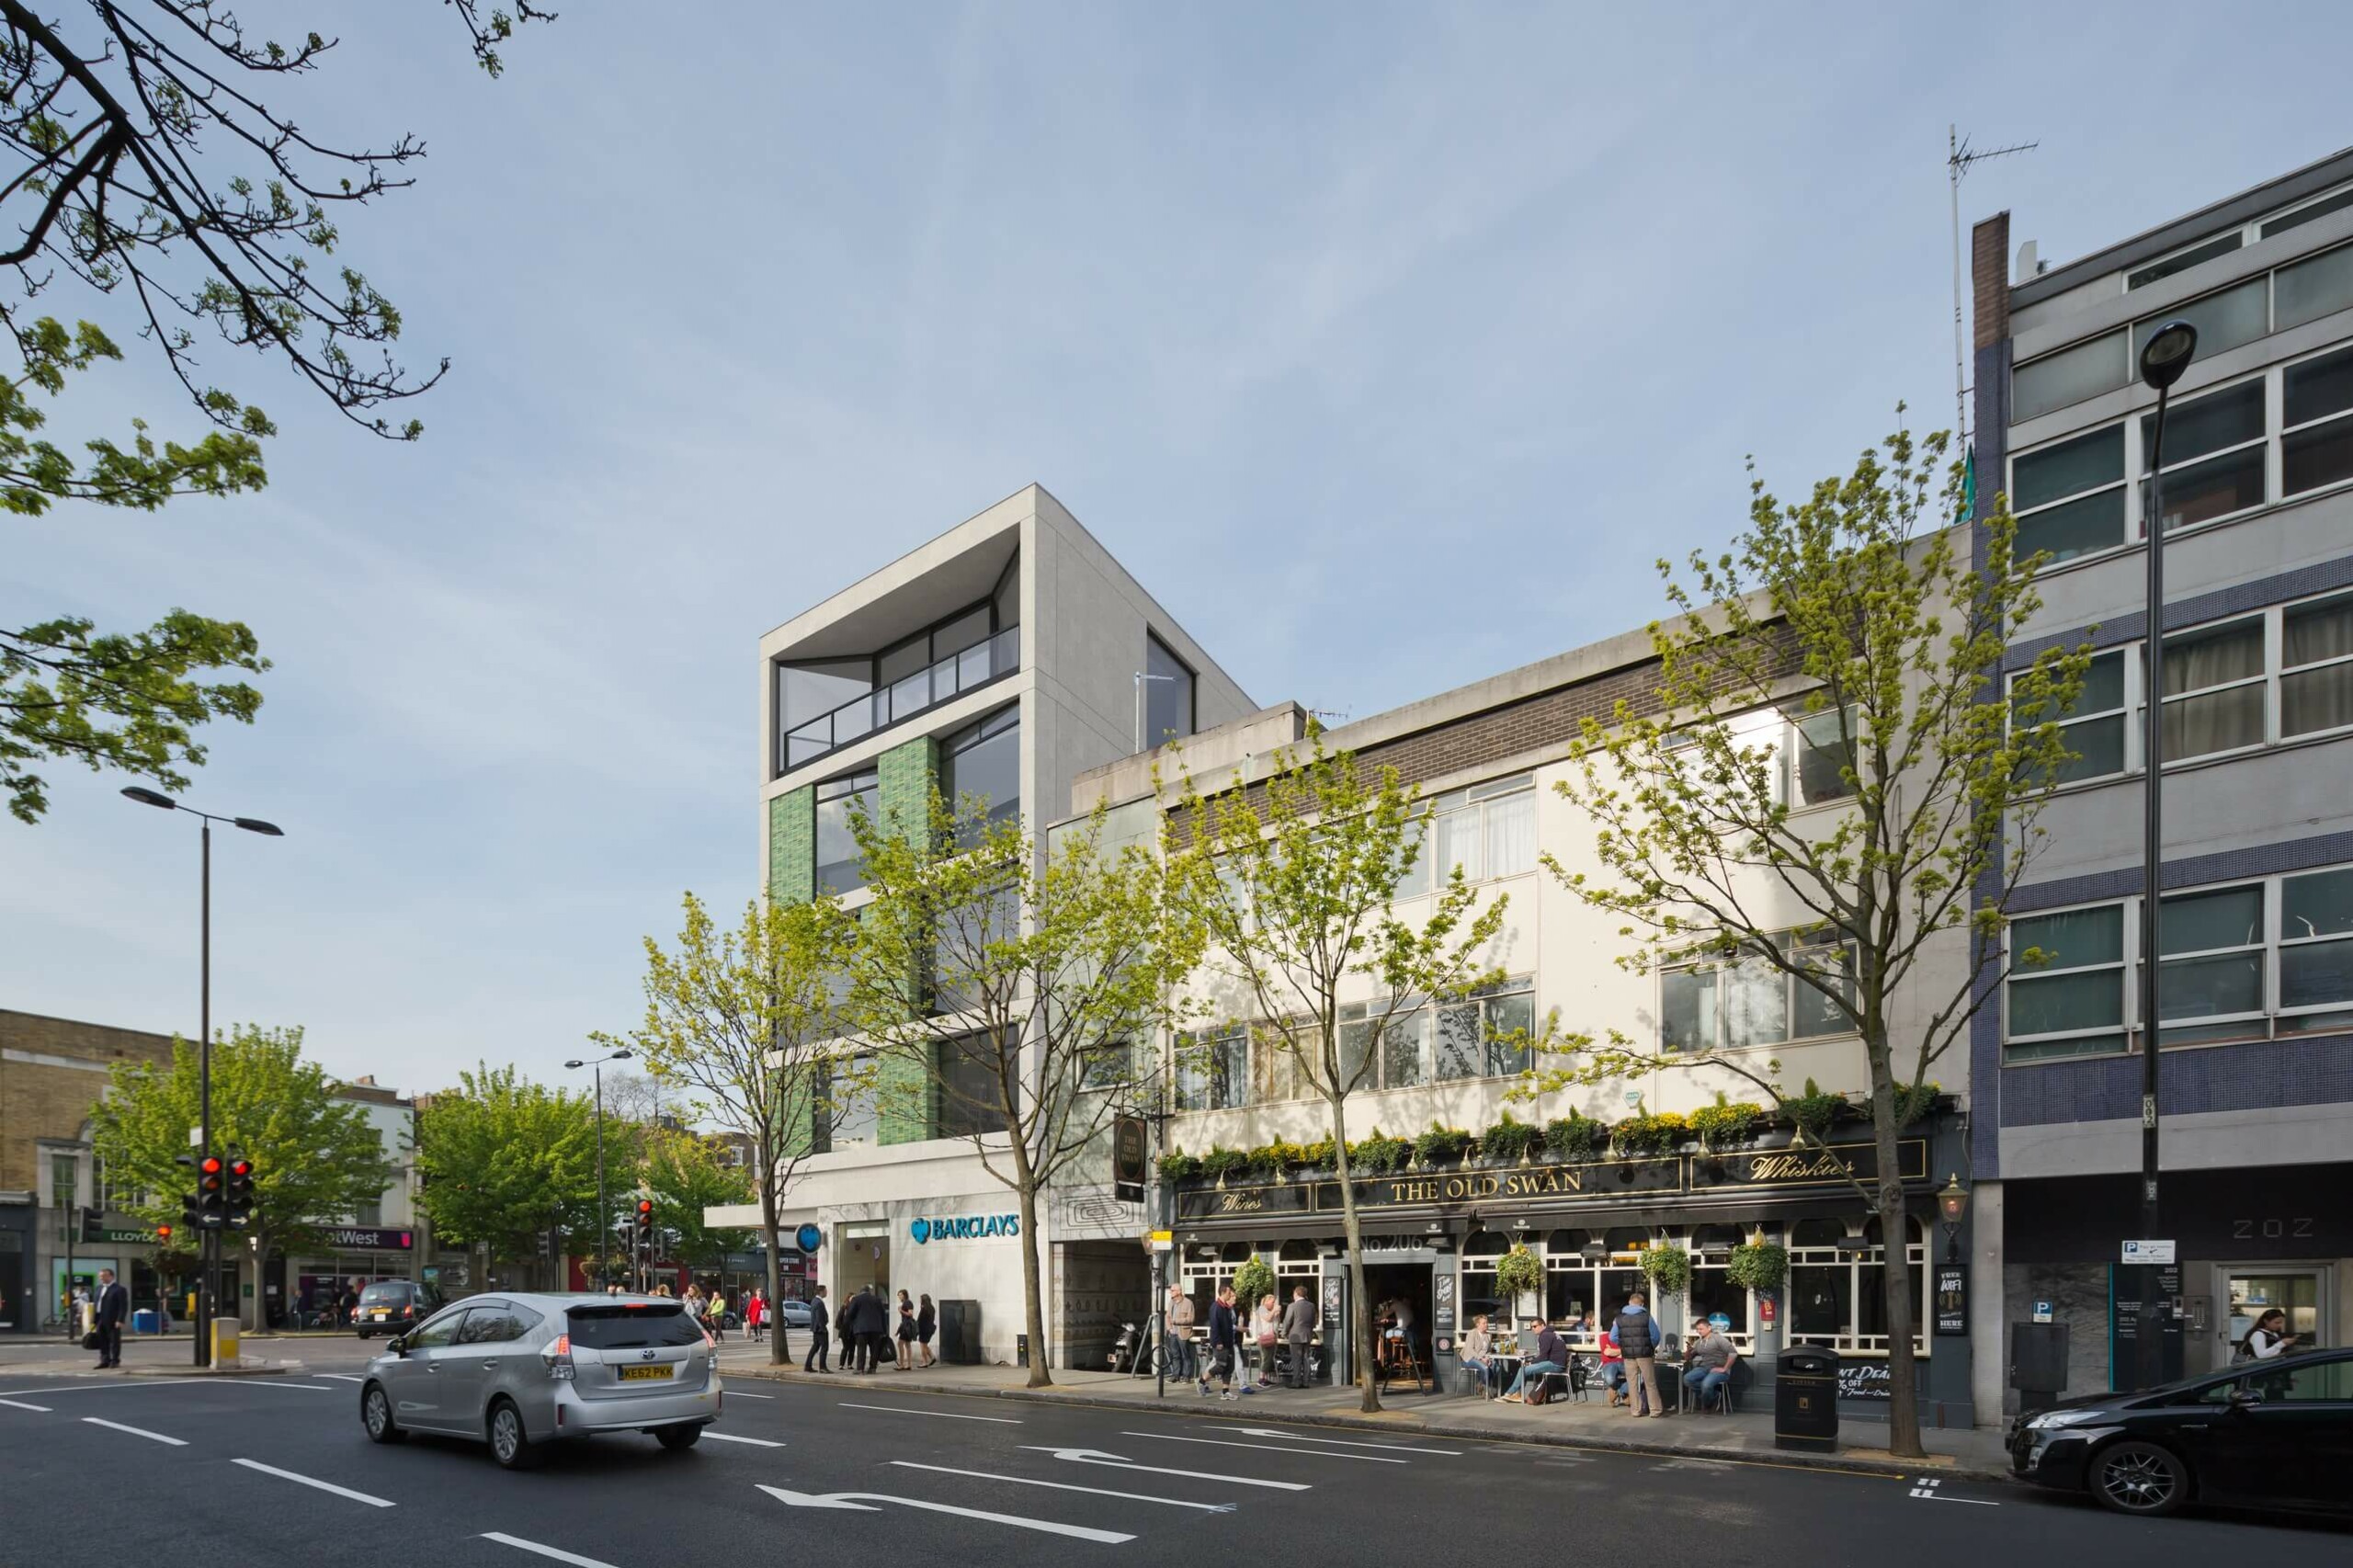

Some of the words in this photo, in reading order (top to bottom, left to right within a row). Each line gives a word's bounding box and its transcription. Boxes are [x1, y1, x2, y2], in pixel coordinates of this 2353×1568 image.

[1125, 1136, 1137, 1144] THE
[1123, 1144, 1138, 1154] OLD
[1392, 1180, 1438, 1202] THE
[1446, 1176, 1499, 1199] OLD
[1506, 1171, 1582, 1195] SWAN
[1222, 1193, 1262, 1211] Wines
[931, 1214, 1019, 1240] BARCLAYS
[111, 1232, 155, 1243] LLOYD
[313, 1230, 380, 1245] atWest
[624, 1367, 651, 1379] KE62
